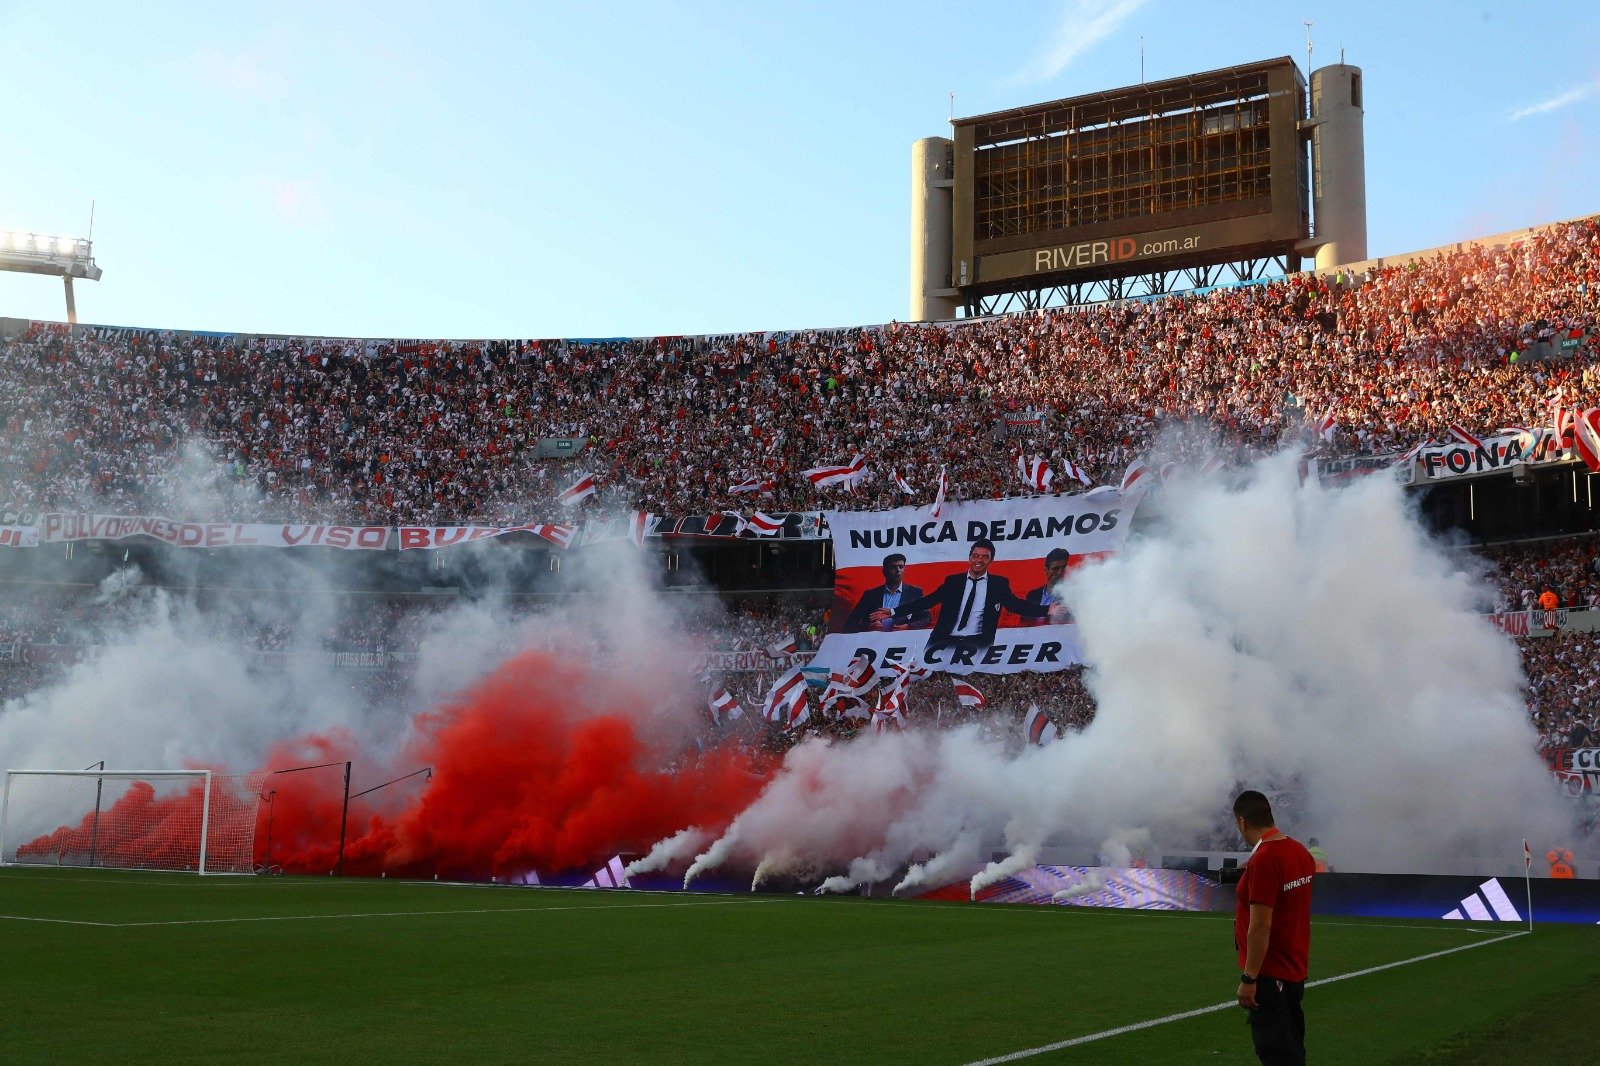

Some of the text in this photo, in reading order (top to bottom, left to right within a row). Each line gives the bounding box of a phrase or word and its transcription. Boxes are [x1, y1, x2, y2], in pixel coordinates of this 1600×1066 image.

[46, 513, 179, 542] POLVORINES
[178, 524, 386, 548] DEL VISO
[850, 520, 959, 549] NUNCA
[966, 508, 1122, 542] DEJAMOS
[847, 642, 1063, 670] DE CREER
